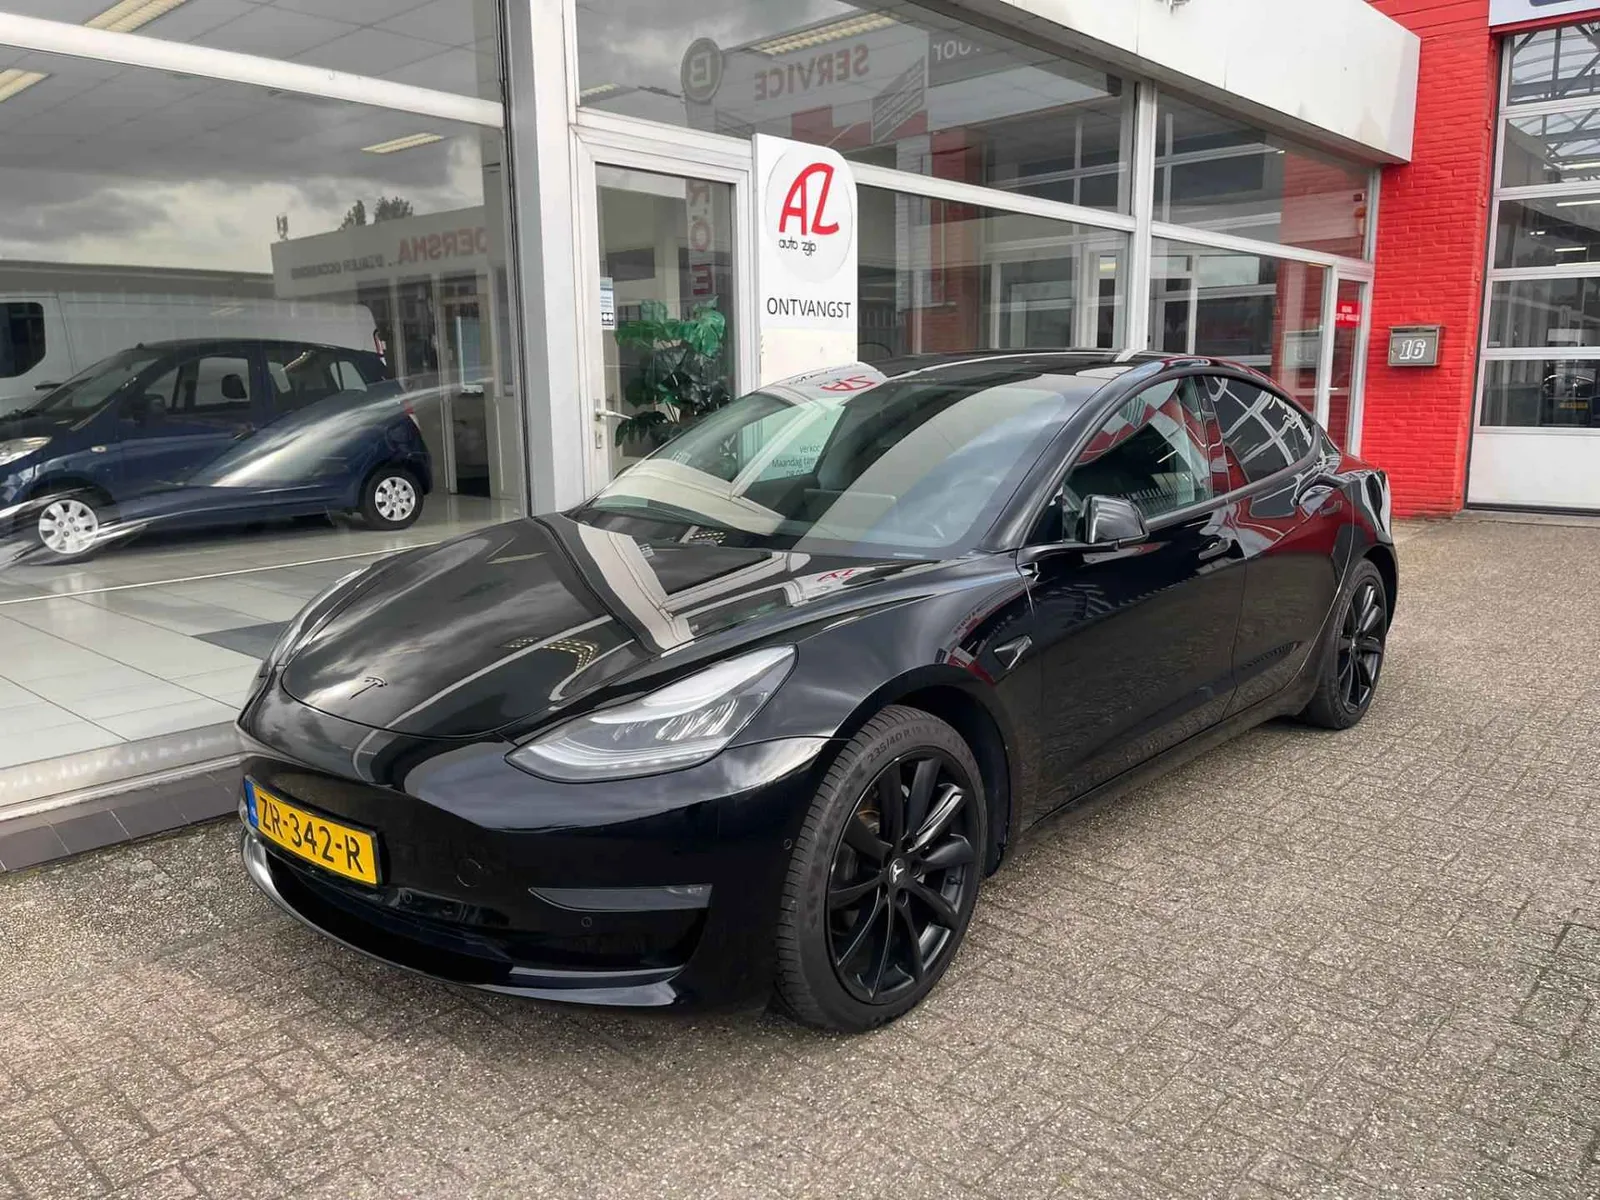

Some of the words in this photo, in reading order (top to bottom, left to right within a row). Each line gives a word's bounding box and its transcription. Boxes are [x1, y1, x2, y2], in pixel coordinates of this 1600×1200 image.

[778, 236, 799, 250] auto
[766, 296, 852, 319] ONTVANGST
[1399, 338, 1426, 360] 16
[259, 795, 365, 874] ZR-342-R
